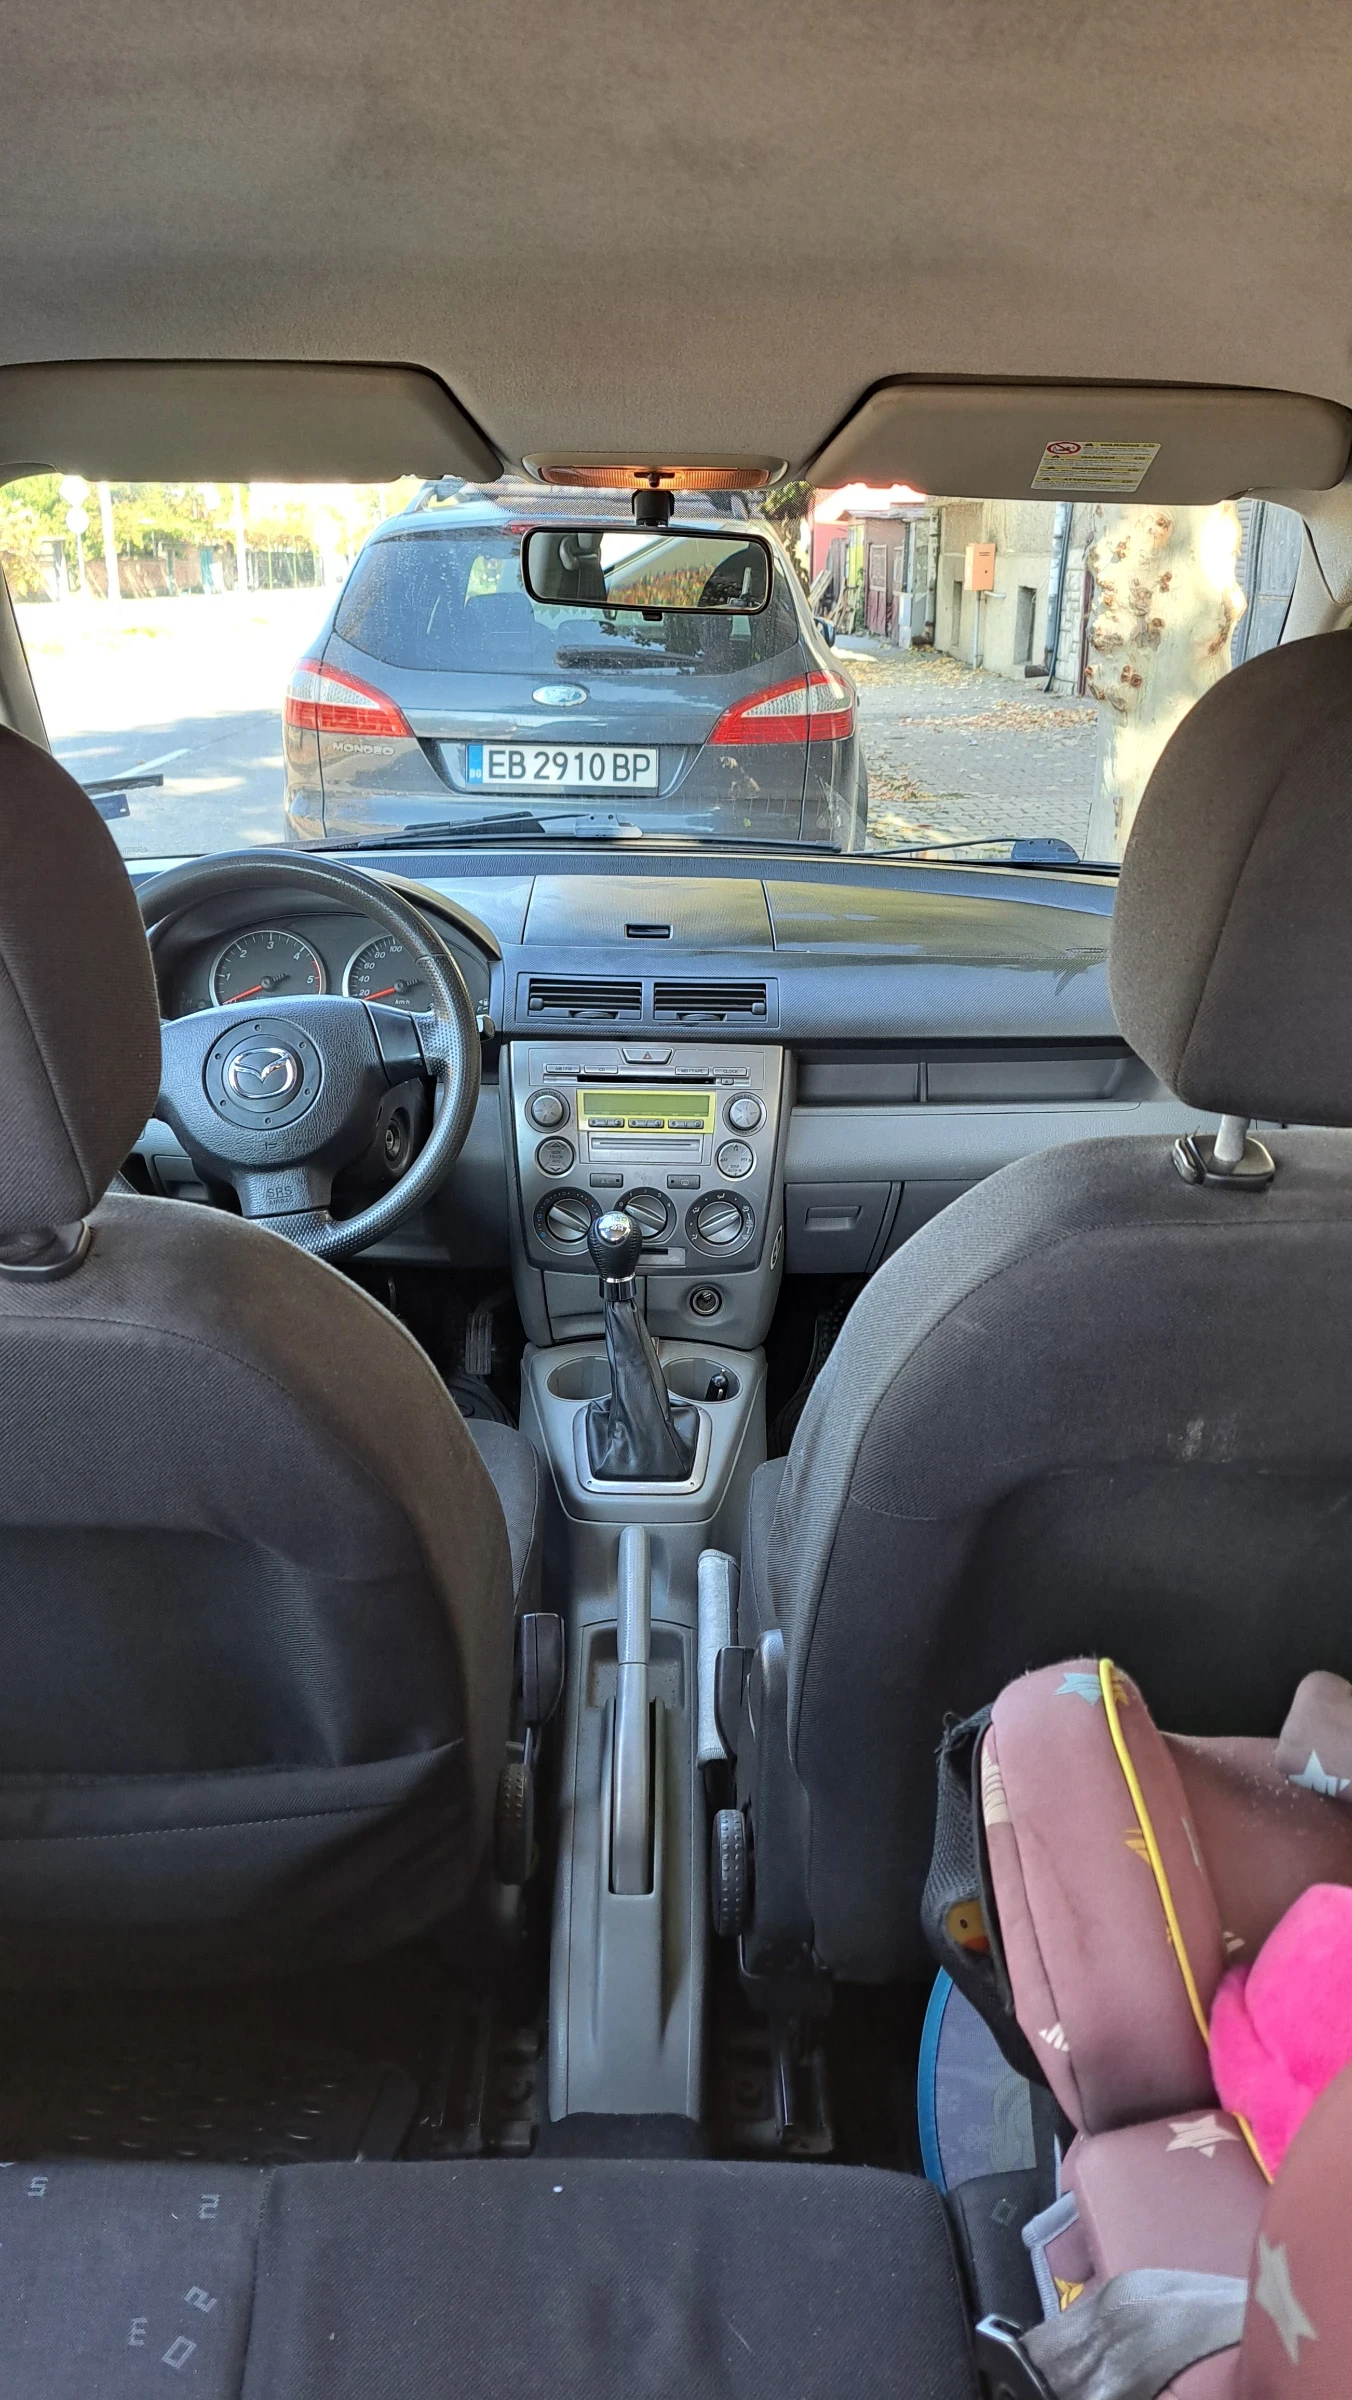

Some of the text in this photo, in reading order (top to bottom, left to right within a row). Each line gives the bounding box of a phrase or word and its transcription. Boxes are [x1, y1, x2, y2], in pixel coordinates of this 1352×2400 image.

[332, 741, 396, 756] MONDEO
[488, 750, 651, 783] EB 2910 BP
[469, 768, 482, 779] BG
[266, 941, 274, 950] 3
[388, 945, 403, 953] 100
[239, 949, 248, 958] 2
[292, 952, 300, 961] 4
[374, 951, 386, 959] 80
[363, 961, 375, 970] 60
[224, 972, 231, 981] 1
[306, 975, 314, 984] 5
[358, 975, 370, 983] 40
[358, 988, 370, 997] 20
[267, 1186, 293, 1198] SRS
